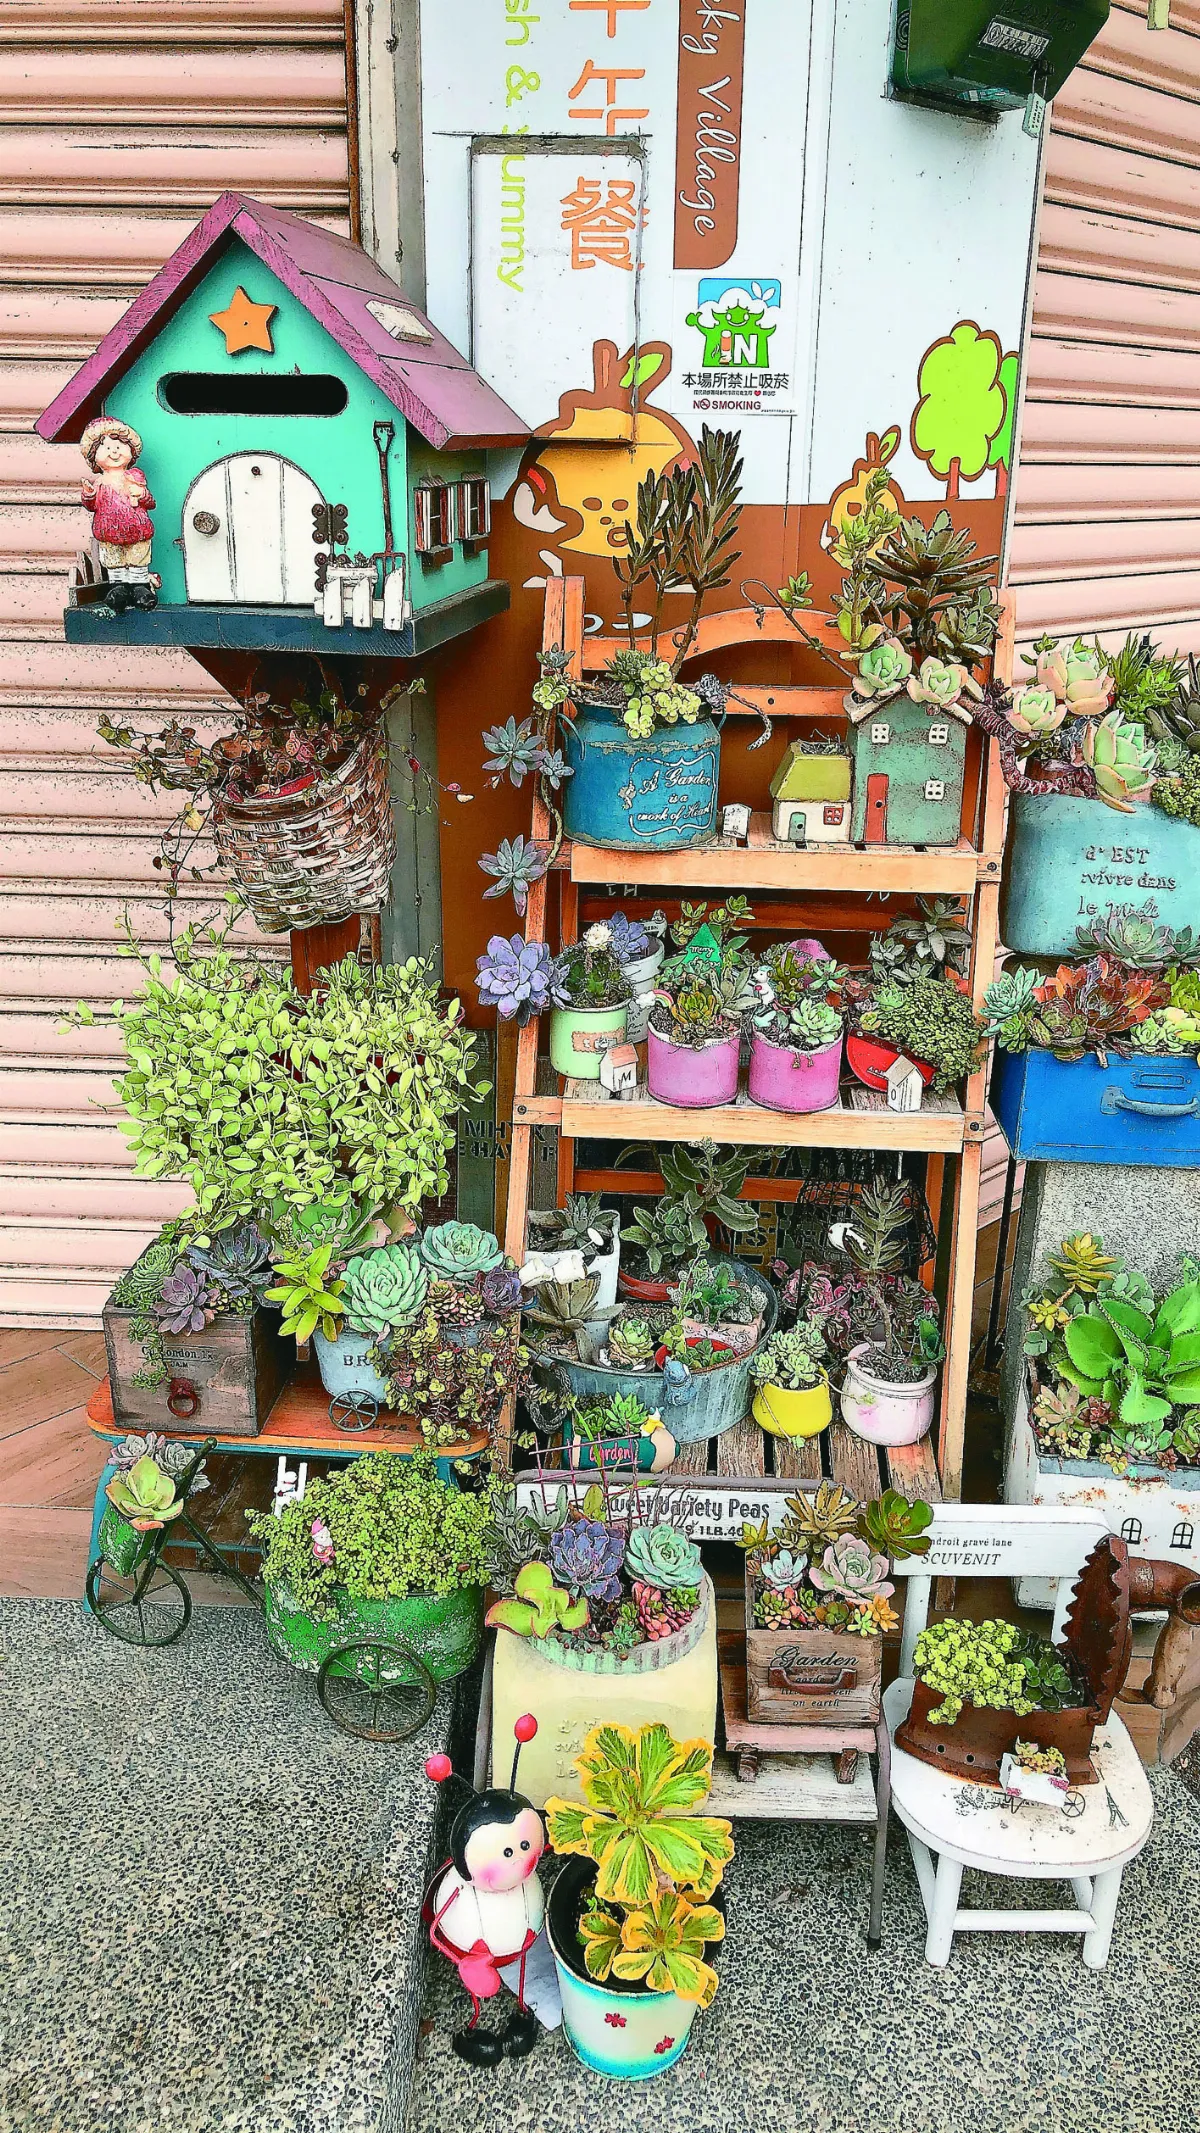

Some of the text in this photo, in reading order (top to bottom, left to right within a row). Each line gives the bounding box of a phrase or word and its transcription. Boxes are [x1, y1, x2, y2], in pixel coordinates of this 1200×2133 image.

[506, 65, 540, 106] &
[679, 75, 738, 237] Village
[681, 371, 790, 390] 本場所禁止吸菸
[711, 400, 762, 411] SMOKING
[664, 766, 712, 788] Garden
[728, 1498, 770, 1519] Peas
[769, 1644, 860, 1671] Garden
[811, 1699, 840, 1707] earth
